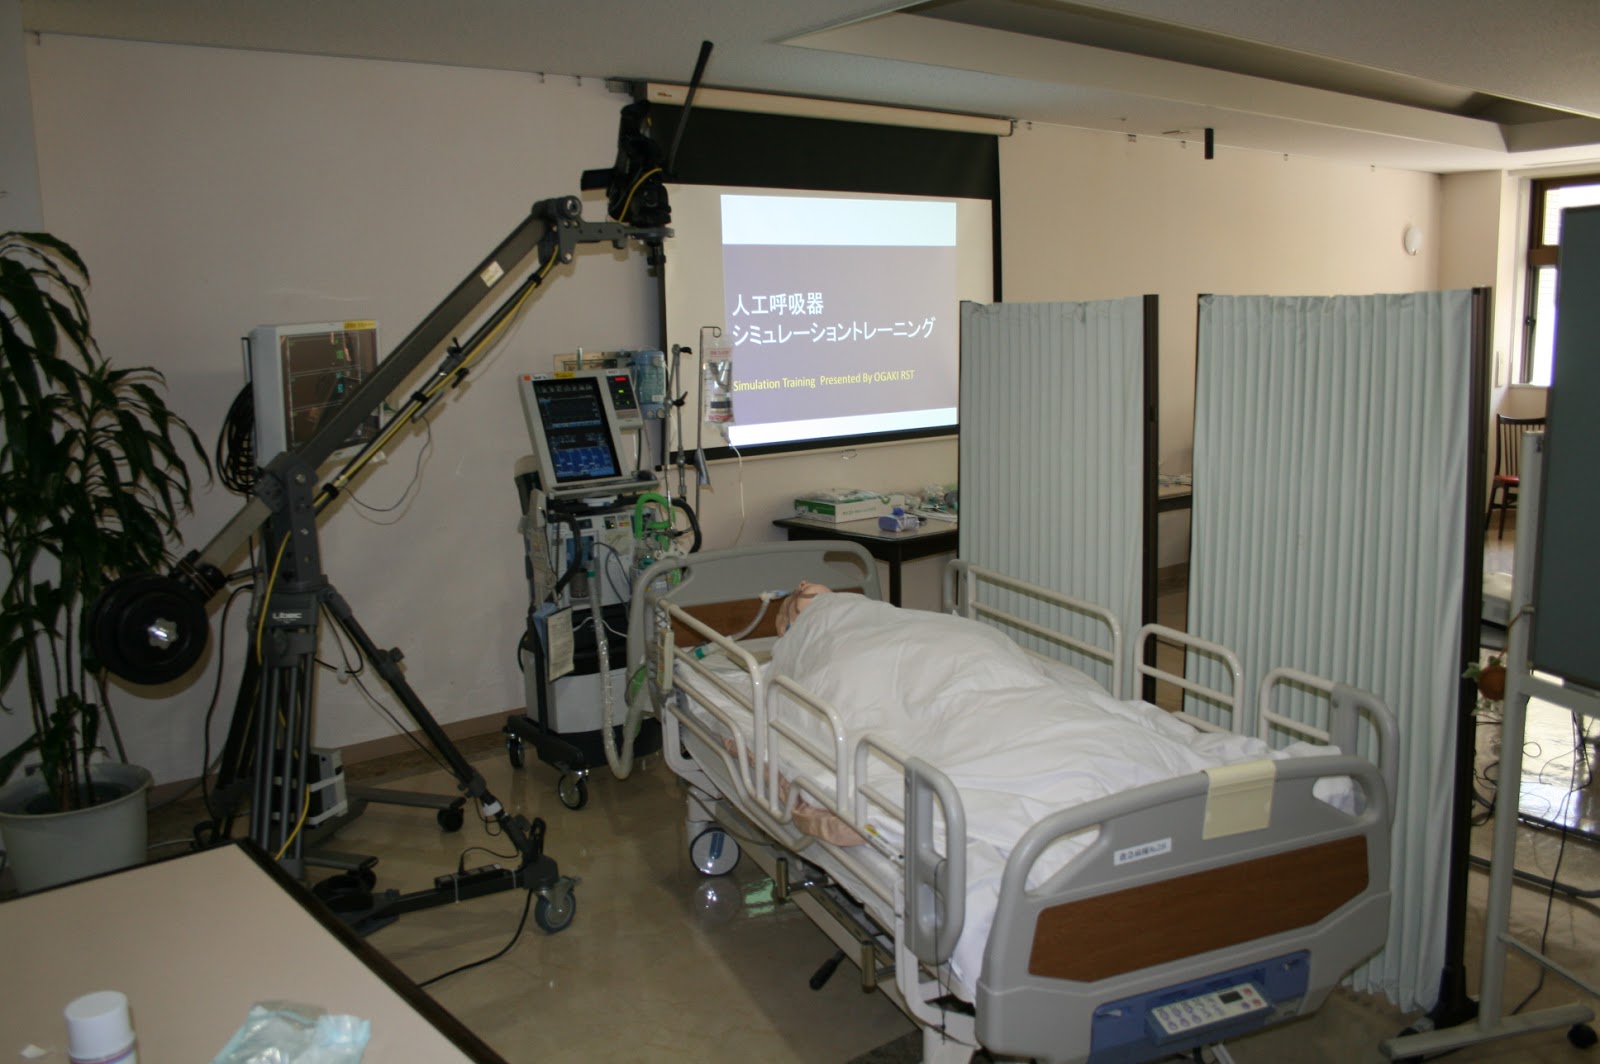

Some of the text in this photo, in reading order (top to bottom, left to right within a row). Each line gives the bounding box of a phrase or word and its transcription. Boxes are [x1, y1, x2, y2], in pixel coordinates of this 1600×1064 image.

[732, 292, 824, 316] 人工呼吸器
[732, 317, 936, 346] シミュレーショントレーニング
[733, 369, 915, 392] Simulation Training Presented By OGAKI RST
